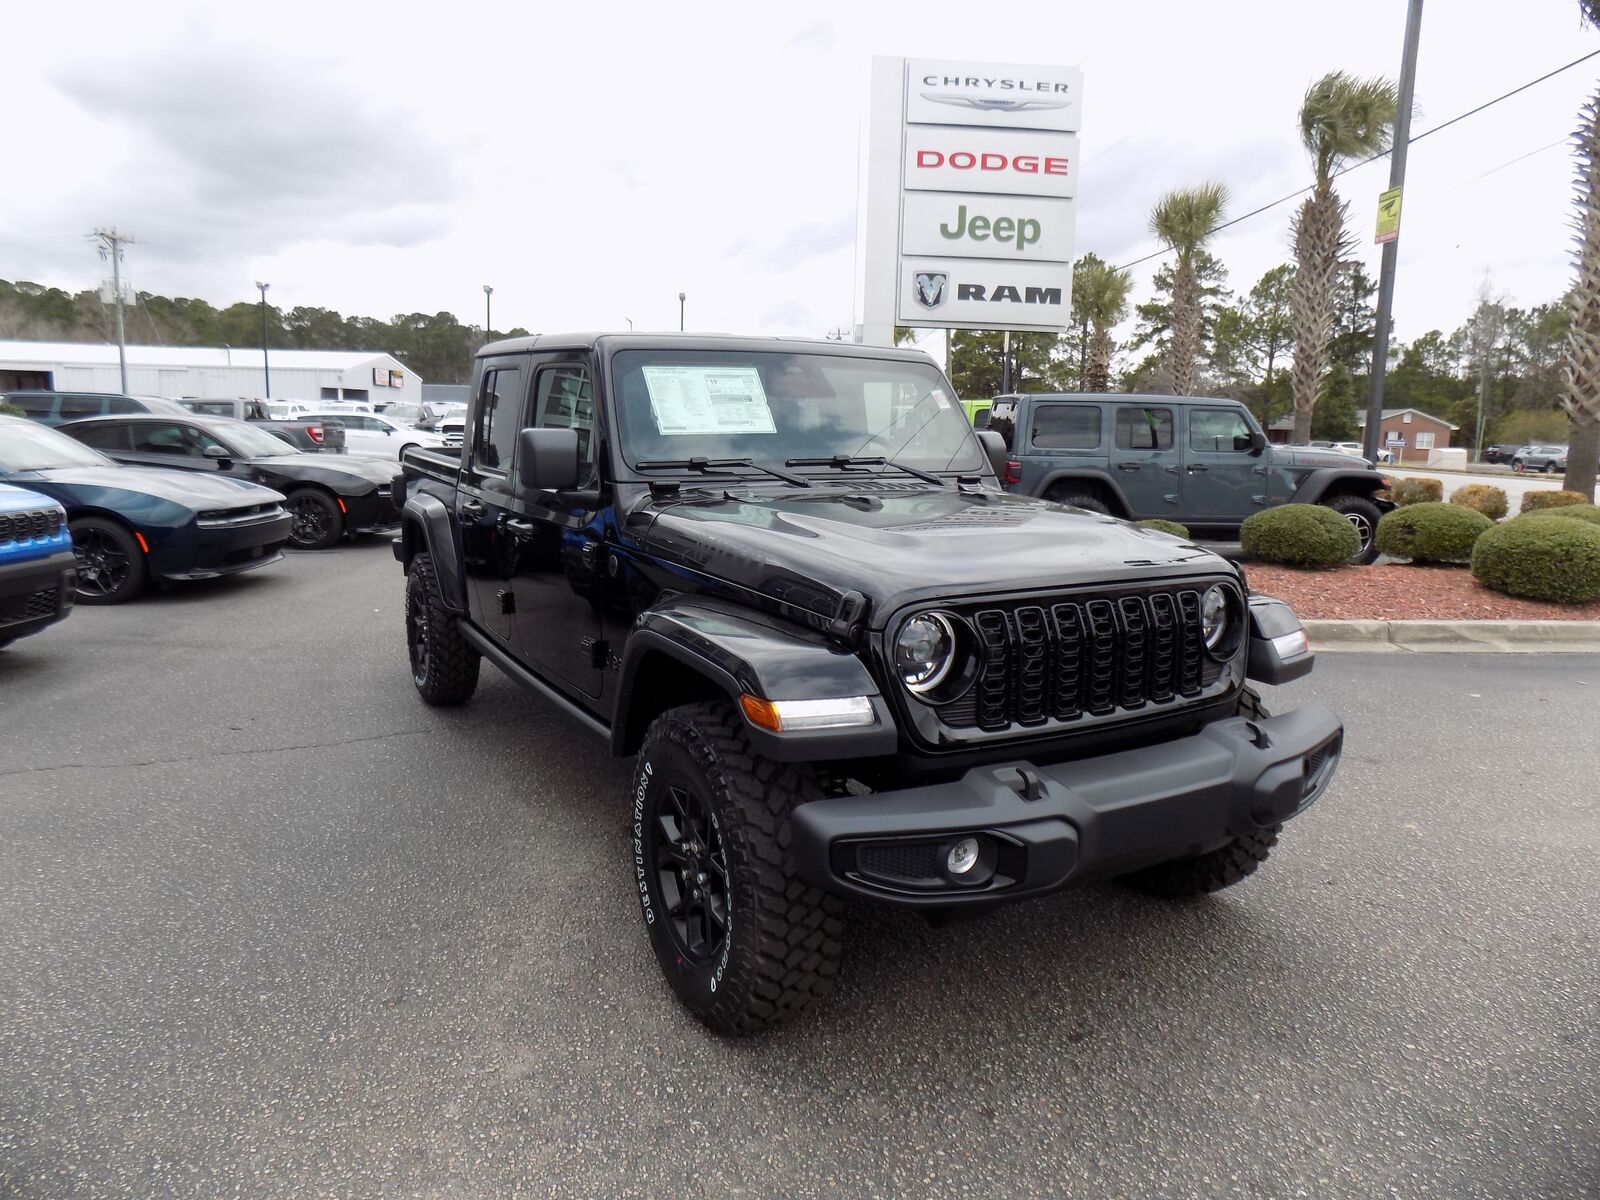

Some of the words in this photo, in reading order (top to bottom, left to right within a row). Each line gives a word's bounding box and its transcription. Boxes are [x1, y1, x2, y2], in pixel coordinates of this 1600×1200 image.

[922, 75, 1069, 93] CHRYSLER
[916, 150, 1069, 176] DODGE
[939, 205, 1042, 251] Jeep
[957, 283, 1062, 305] RAM
[634, 772, 655, 925] DESTINATION
